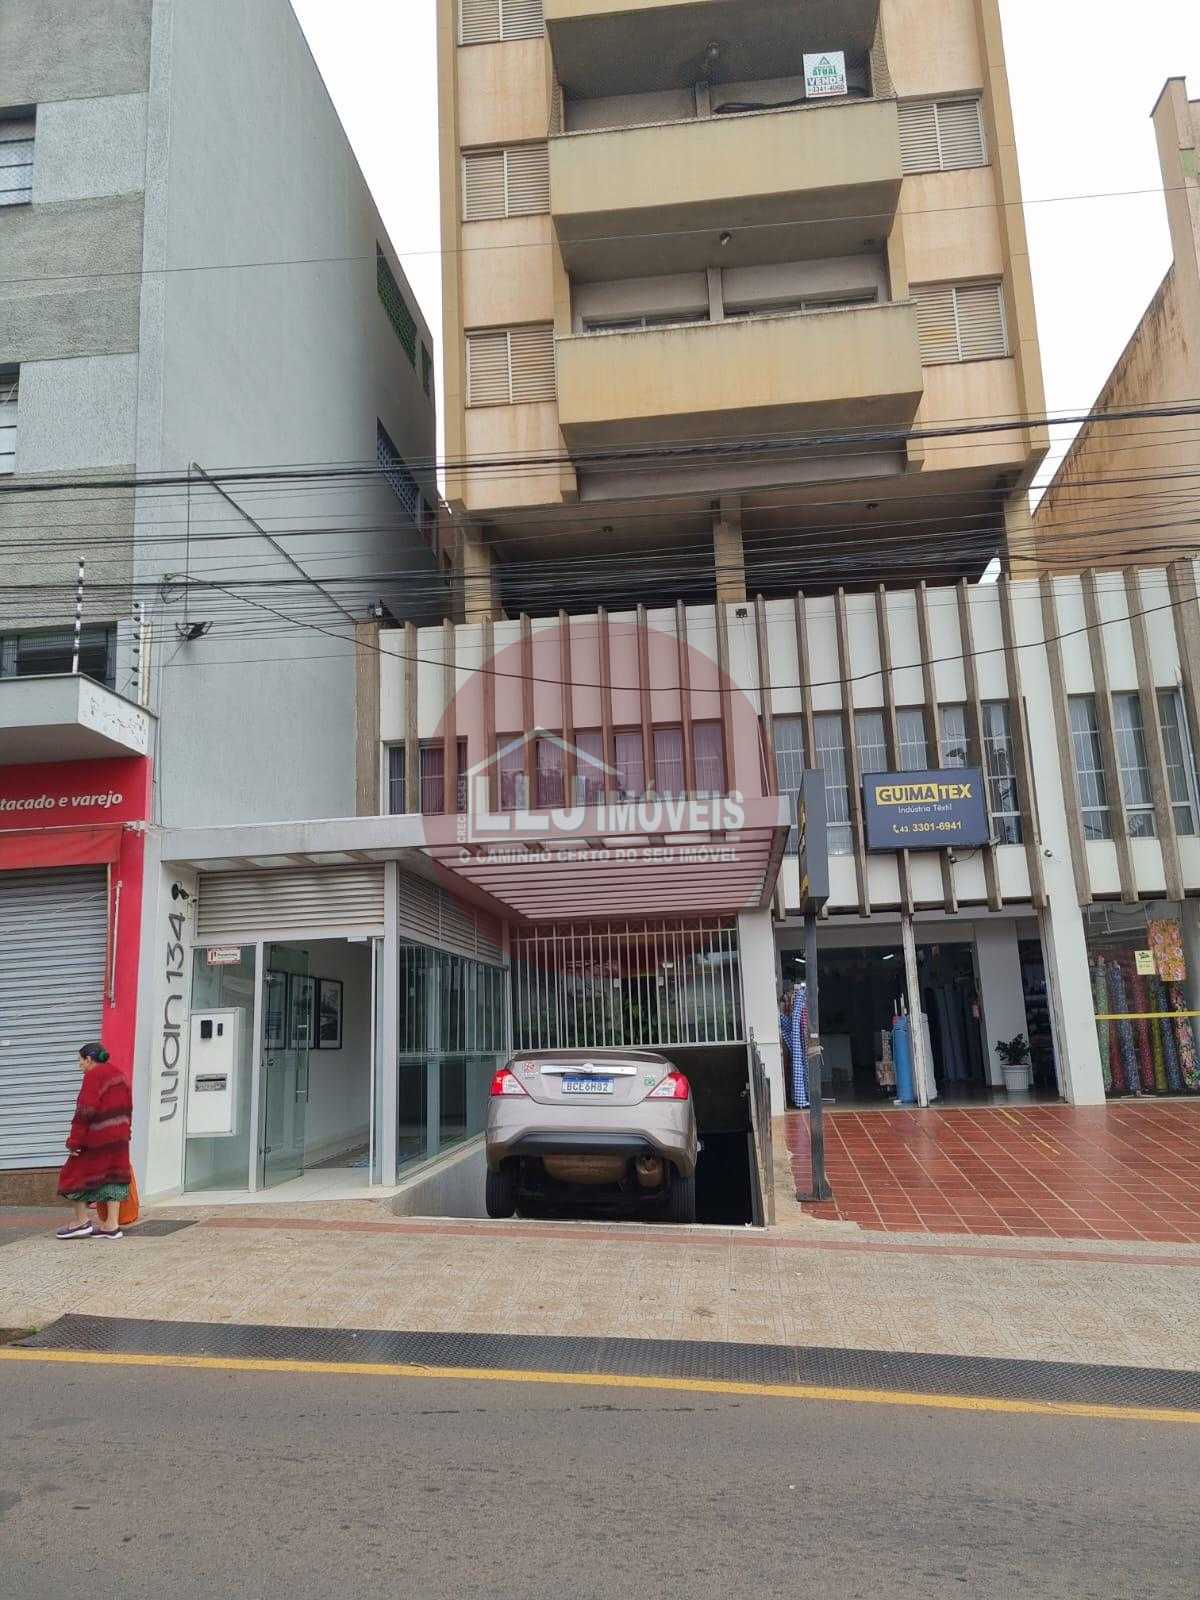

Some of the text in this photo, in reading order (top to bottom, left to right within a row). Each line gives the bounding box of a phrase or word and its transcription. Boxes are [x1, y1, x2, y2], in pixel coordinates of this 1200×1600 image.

[807, 75, 844, 86] VENDE
[0, 790, 123, 811] tacado e varejo
[878, 783, 972, 802] GUIMATEX
